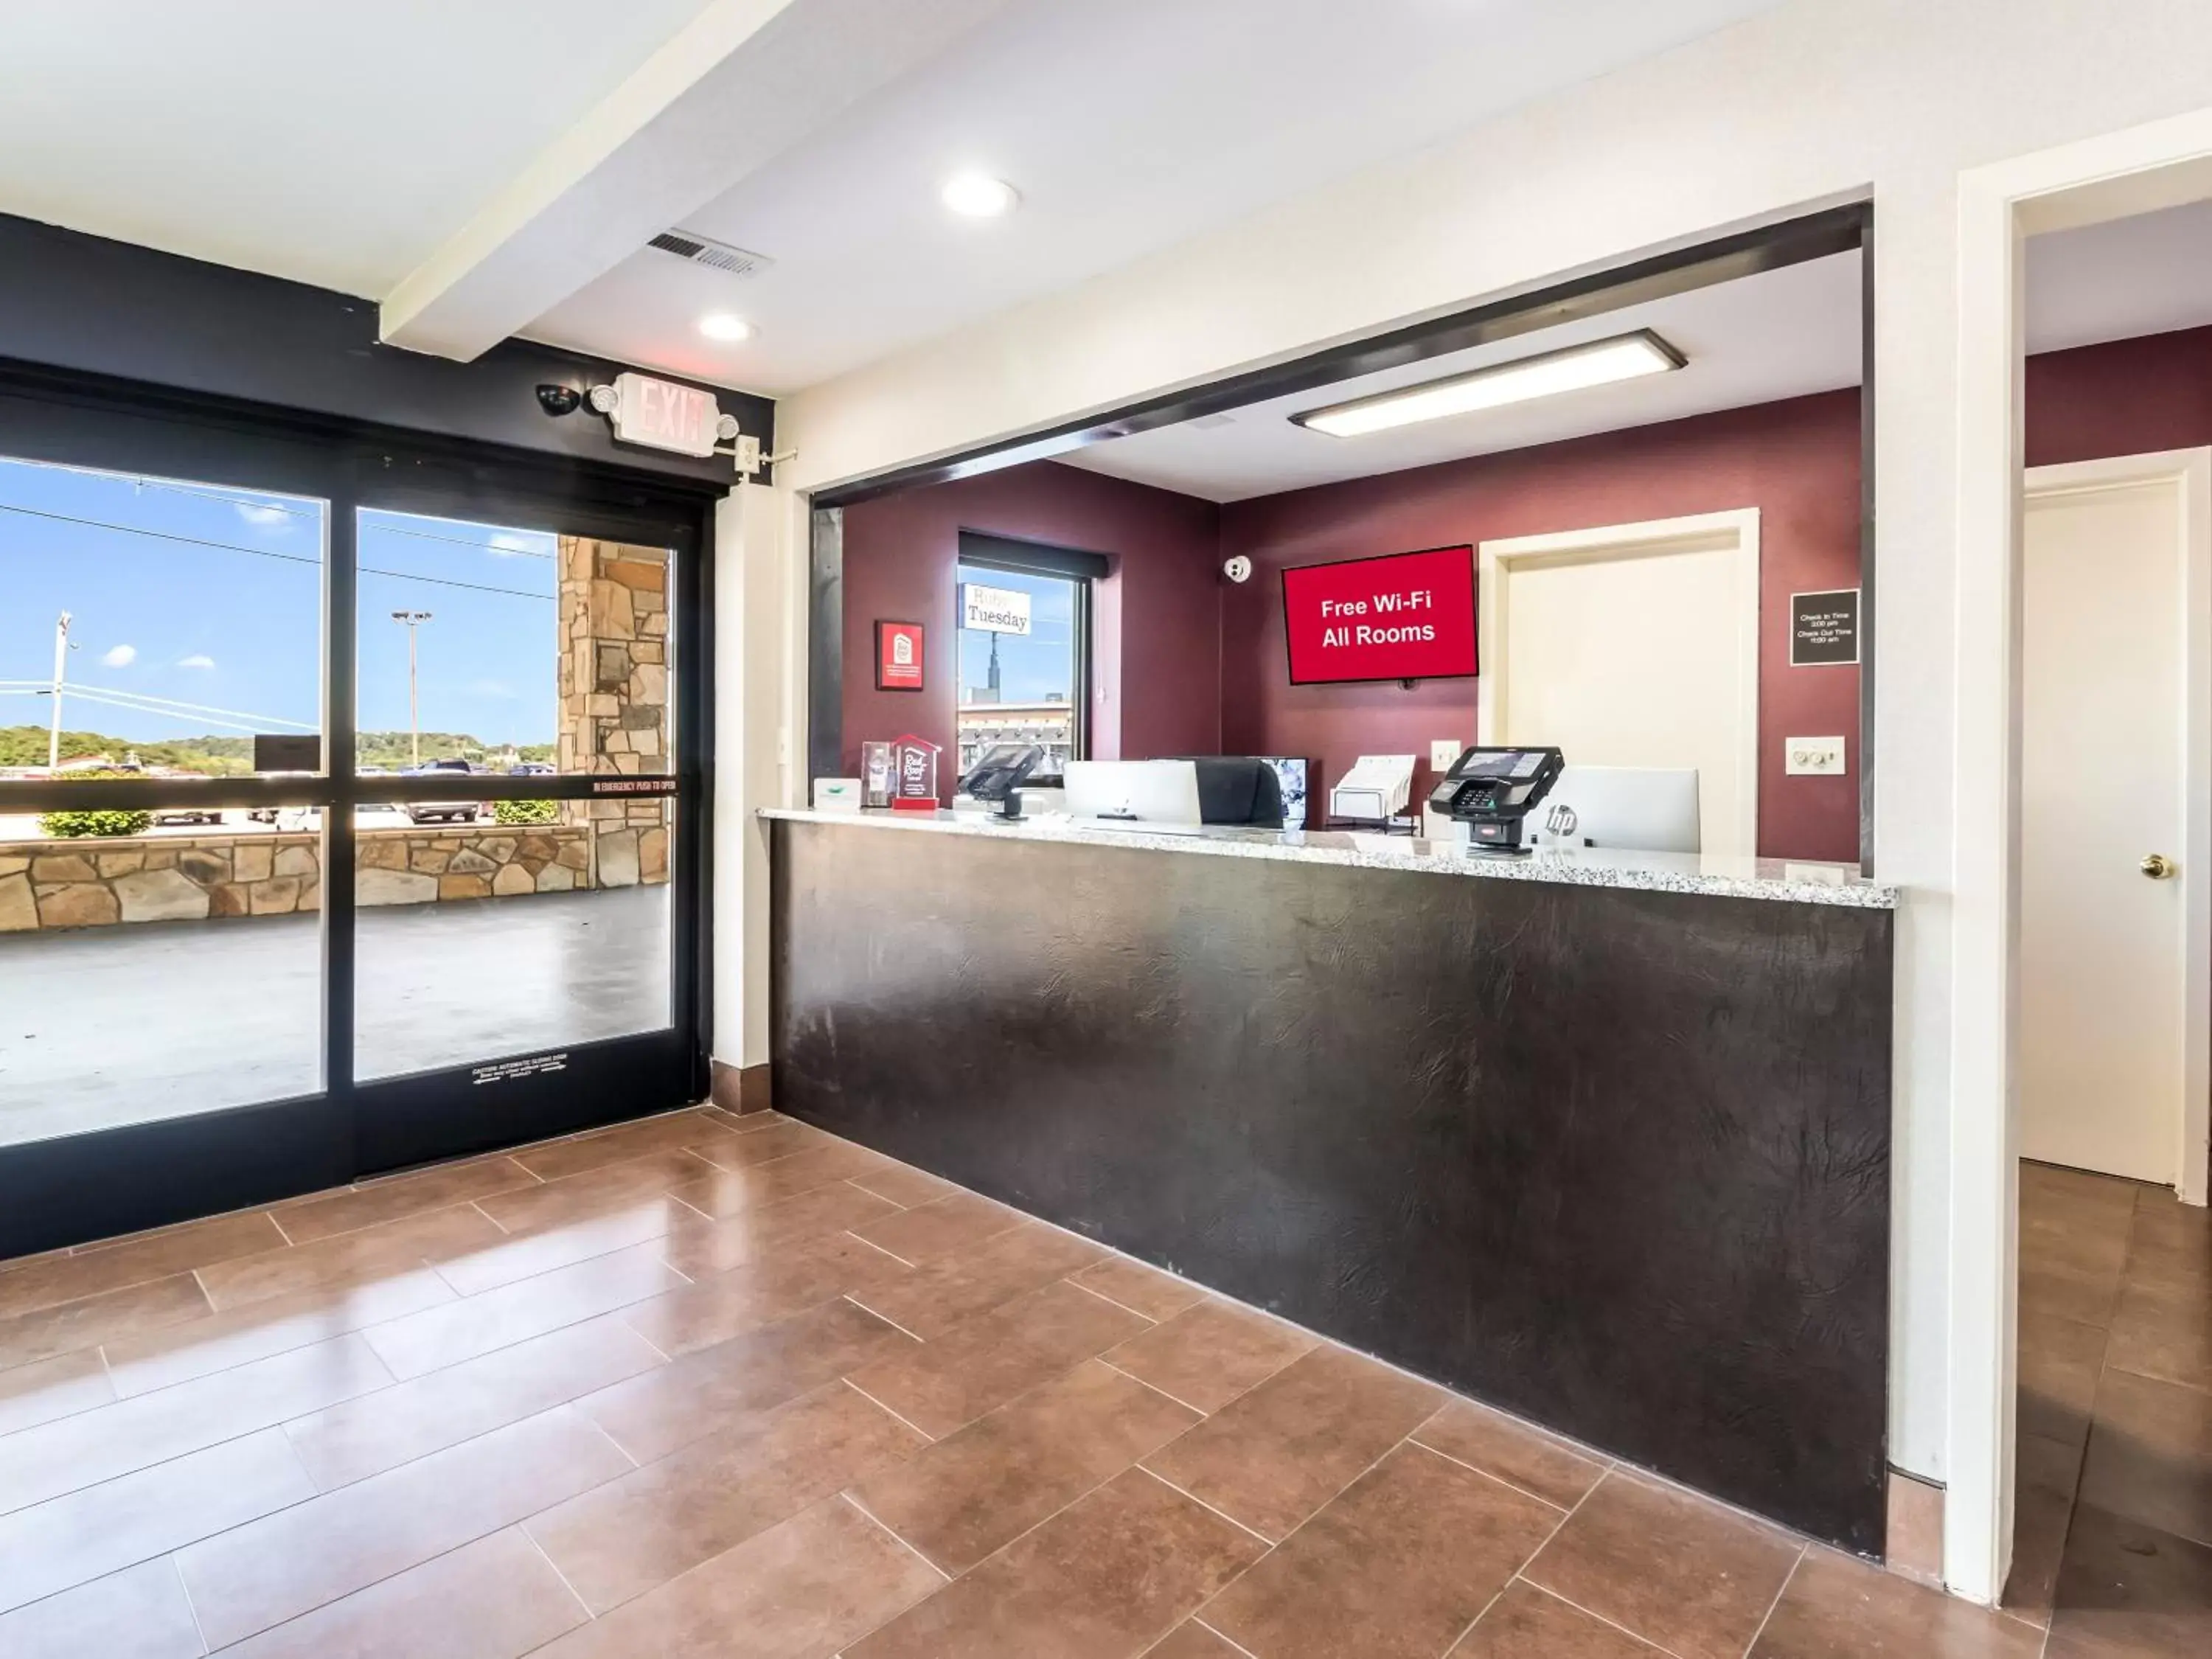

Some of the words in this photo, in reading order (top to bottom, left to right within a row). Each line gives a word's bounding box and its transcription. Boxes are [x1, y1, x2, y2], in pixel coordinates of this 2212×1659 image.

[641, 380, 706, 442] EXIT
[1321, 599, 1368, 618] Free
[1373, 590, 1432, 613] Wi-Fi
[968, 605, 1027, 632] Tuesday
[1322, 627, 1350, 647] All
[1356, 624, 1436, 646] Rooms
[601, 782, 634, 791] EMERGENCY
[636, 782, 652, 790] PUSH
[653, 782, 660, 790] TO
[660, 781, 675, 790] OPEN
[1548, 804, 1575, 836] hp
